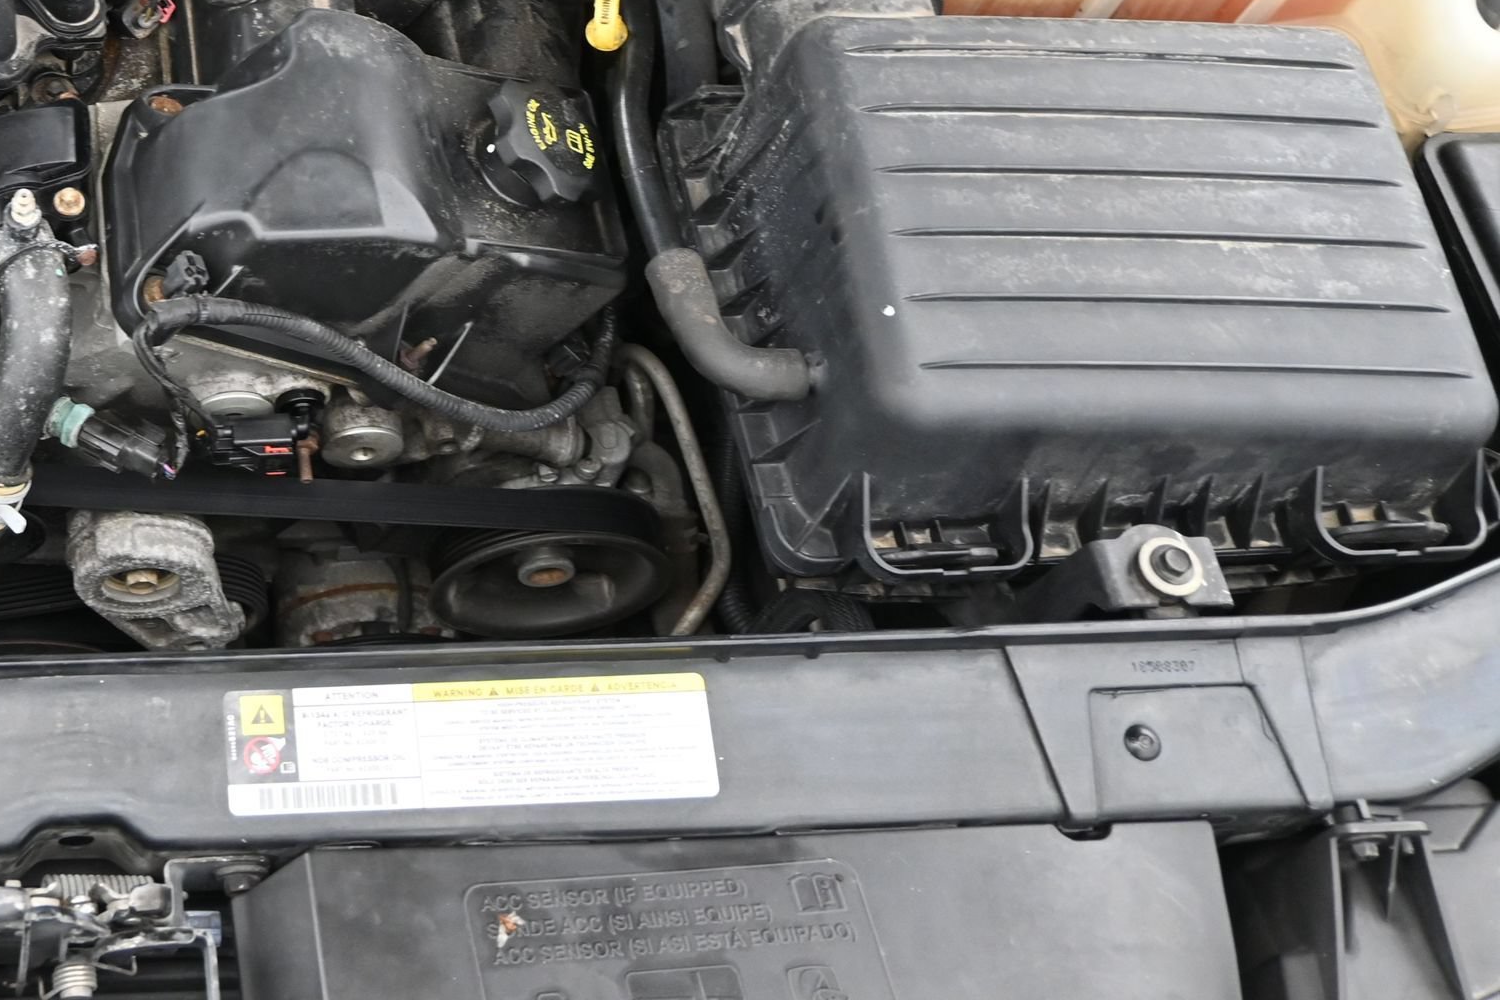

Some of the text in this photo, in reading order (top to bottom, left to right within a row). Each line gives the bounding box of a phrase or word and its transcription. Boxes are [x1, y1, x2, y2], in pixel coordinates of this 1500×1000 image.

[526, 111, 548, 151] ENGINE
[324, 690, 380, 701] ATTENTION
[433, 682, 677, 697] WARNING MISE EN GARDE ADVERTENCIA
[481, 877, 749, 912] ACC SENSOR (IF EQUIPPED)
[487, 902, 773, 939] SNDE ACC (SI AINSI EQUIPE)
[494, 920, 858, 966] ACC SENSOR (SI ASI ESTÁ EQUIPADO)
